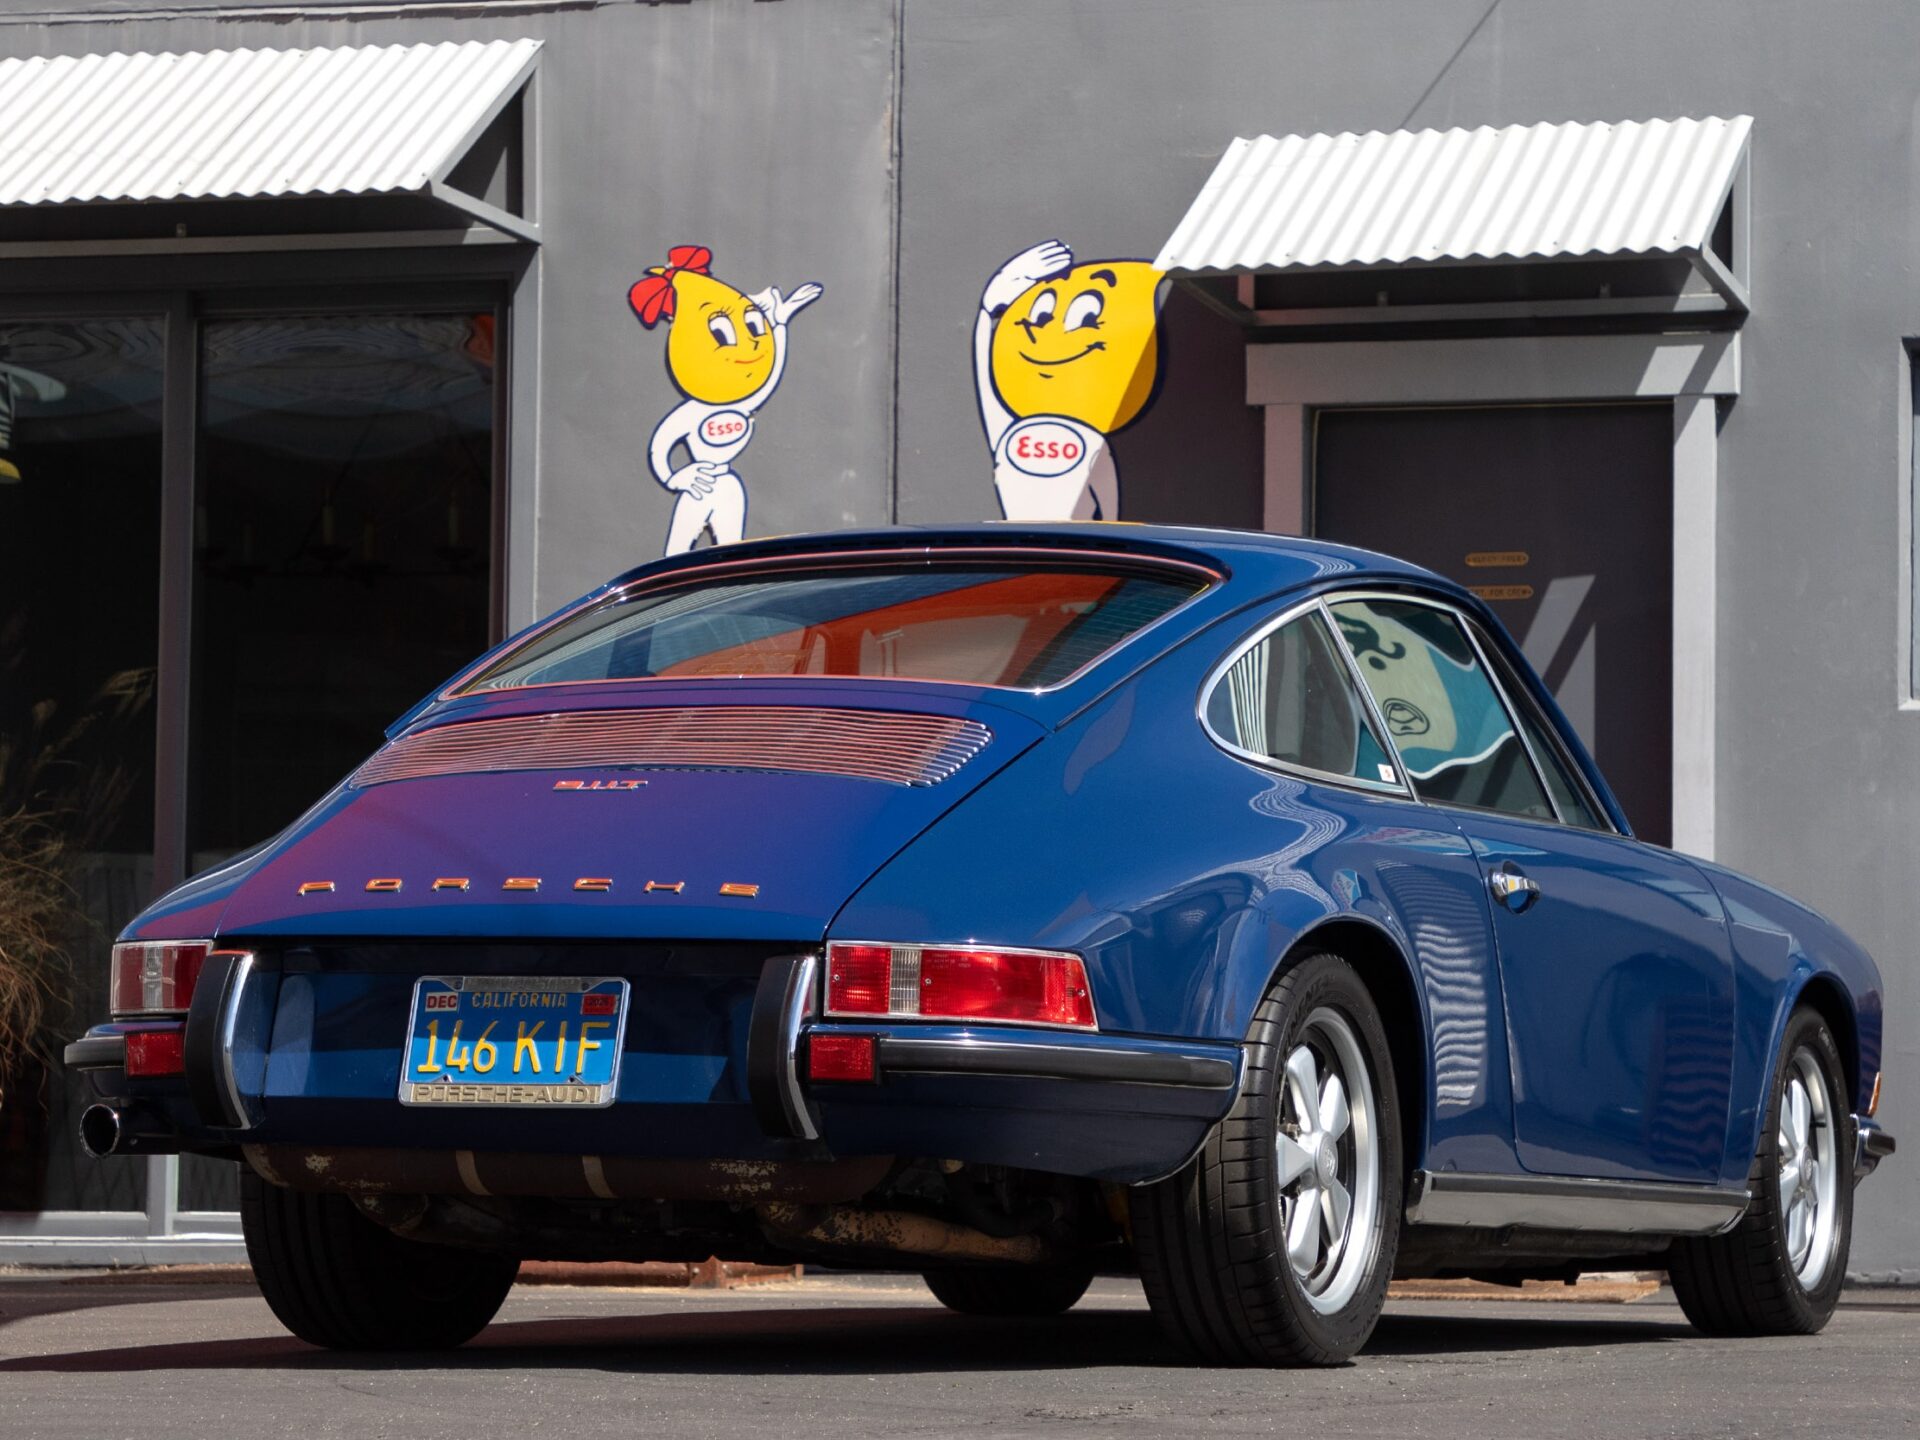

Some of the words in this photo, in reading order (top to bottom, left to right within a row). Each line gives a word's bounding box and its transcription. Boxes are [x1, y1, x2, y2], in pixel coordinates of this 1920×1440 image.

[299, 877, 760, 898] PORSCHE
[427, 995, 458, 1008] DEC
[472, 992, 568, 1008] CALIFORNIA
[417, 1019, 499, 1073] 146
[513, 1020, 611, 1073] KIF
[414, 1086, 599, 1103] PORSCHE-AUDI
